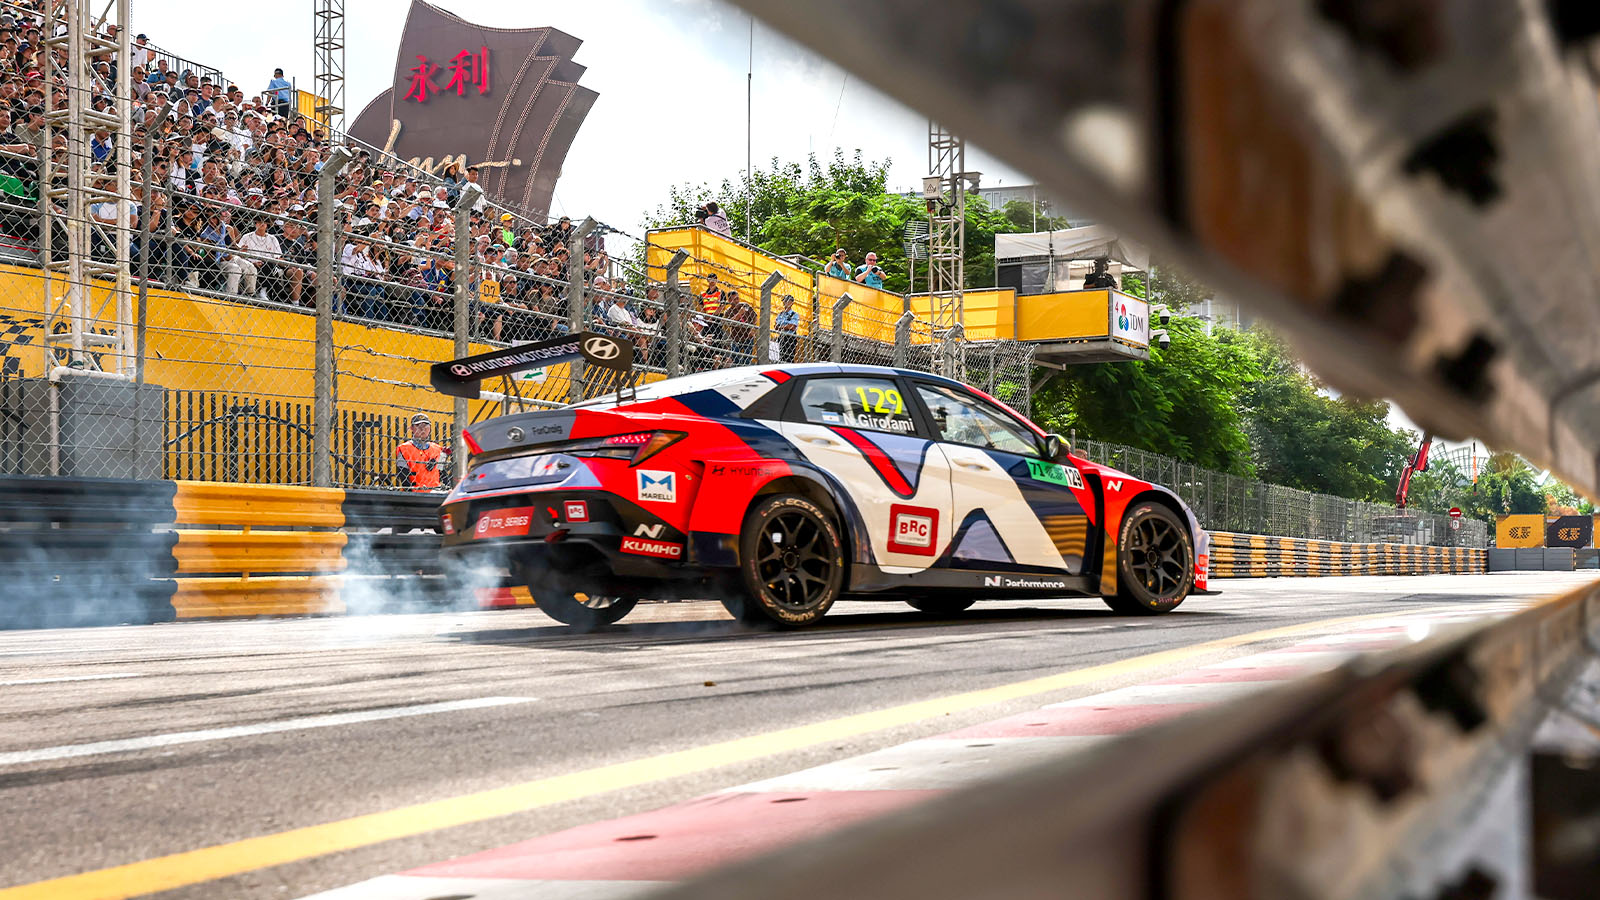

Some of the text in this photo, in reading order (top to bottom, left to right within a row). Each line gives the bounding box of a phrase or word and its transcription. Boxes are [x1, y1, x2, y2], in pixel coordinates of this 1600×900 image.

[402, 46, 488, 102] 永利
[1129, 313, 1144, 333] TDM
[517, 341, 580, 364] MOTORSPORT
[856, 387, 903, 414] 129
[1029, 461, 1045, 477] 71
[1064, 467, 1082, 488] 129
[641, 492, 673, 501] MARELLI
[899, 520, 927, 537] BRC
[623, 540, 681, 556] KUMHO
